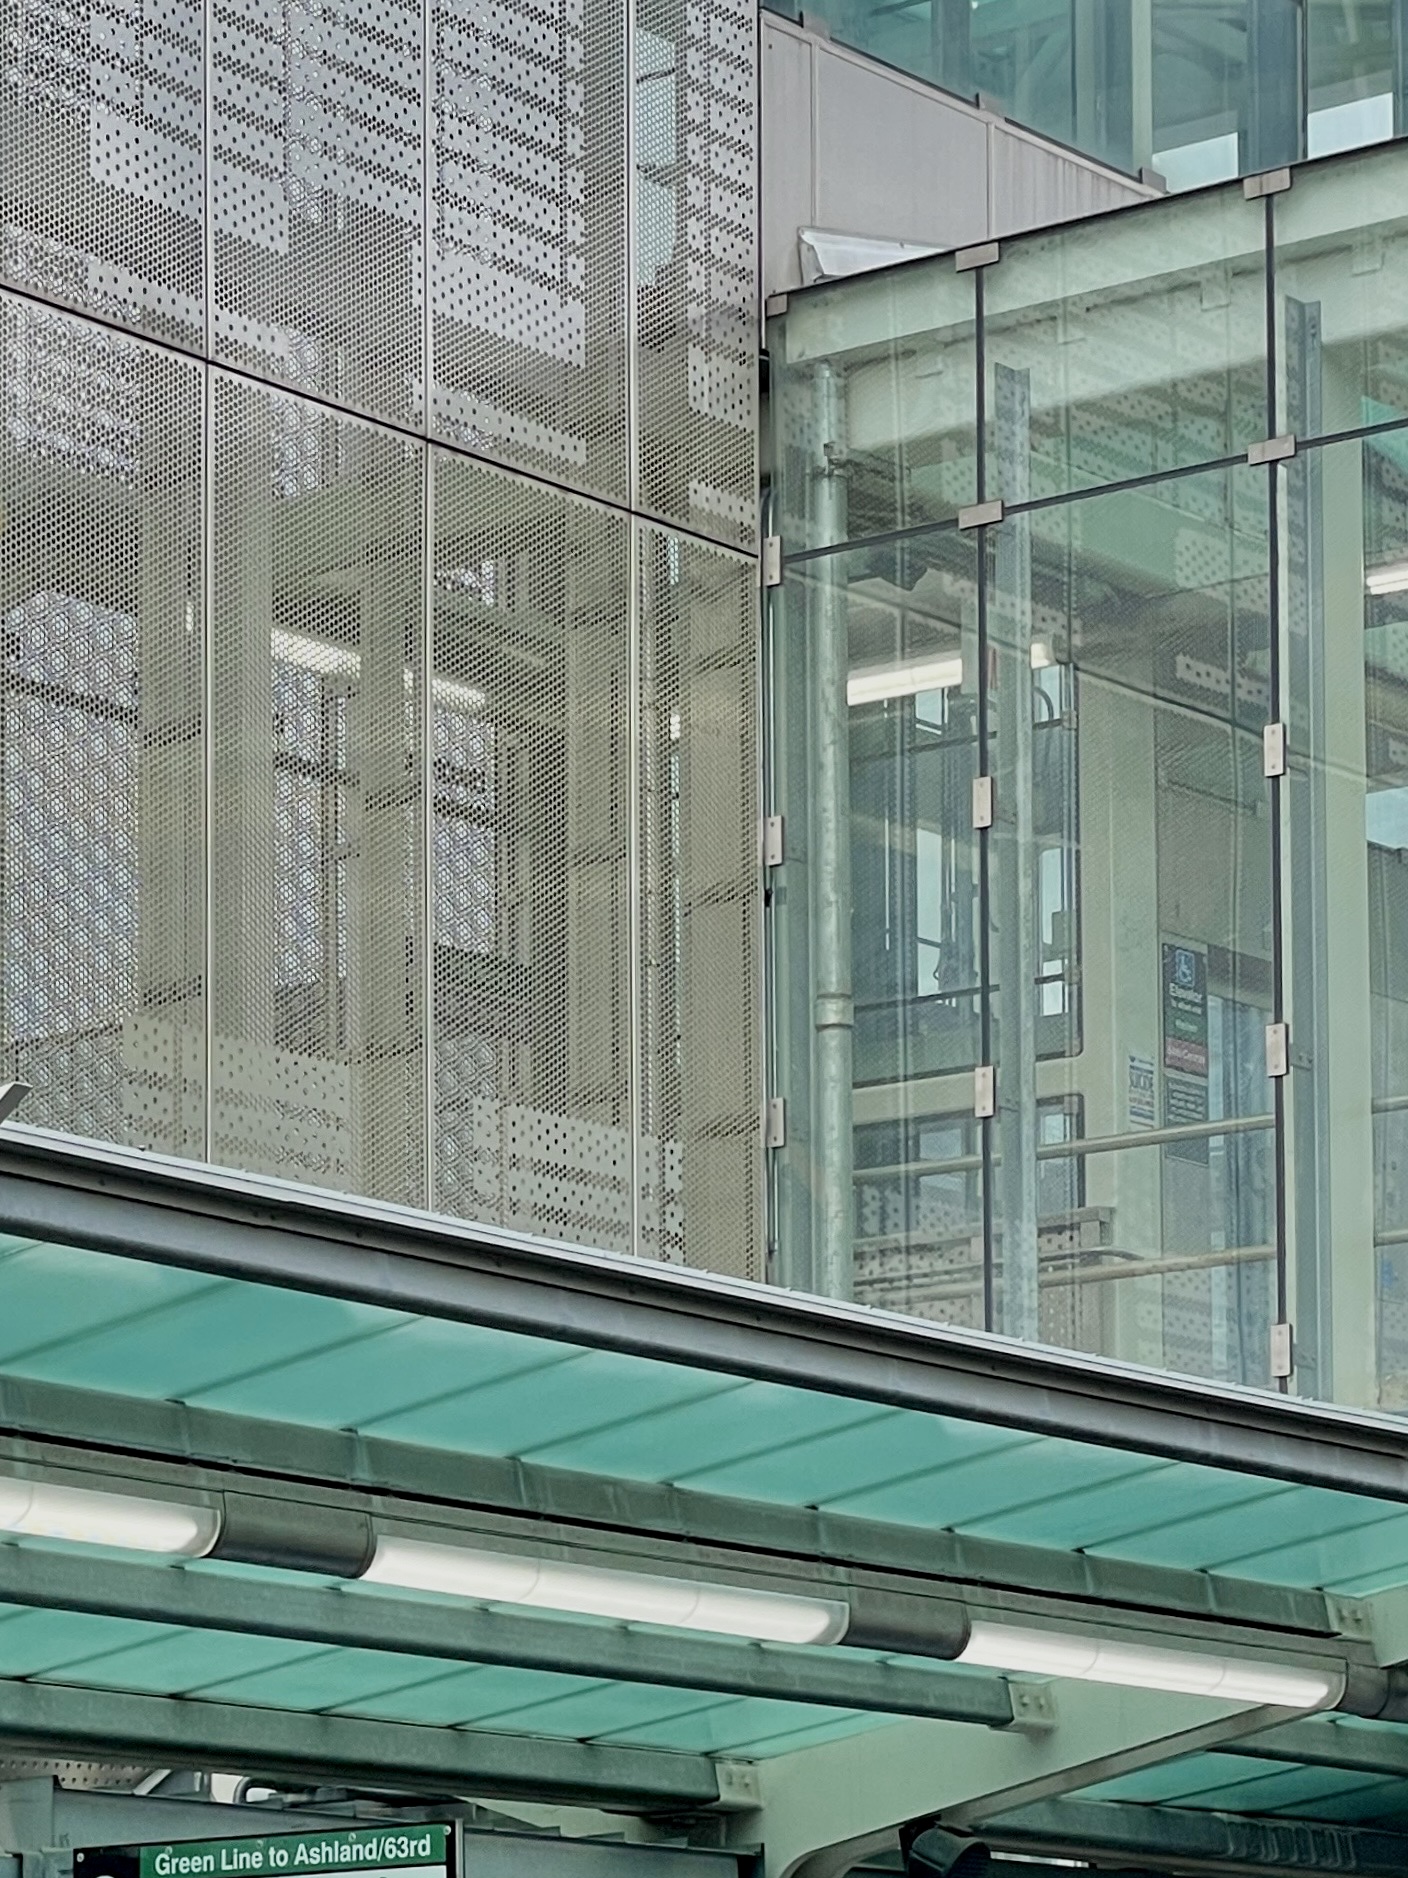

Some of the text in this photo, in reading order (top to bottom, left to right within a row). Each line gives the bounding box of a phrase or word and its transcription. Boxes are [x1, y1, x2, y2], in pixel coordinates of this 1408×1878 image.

[154, 1833, 432, 1876] Green Line to Ashland/63rd
